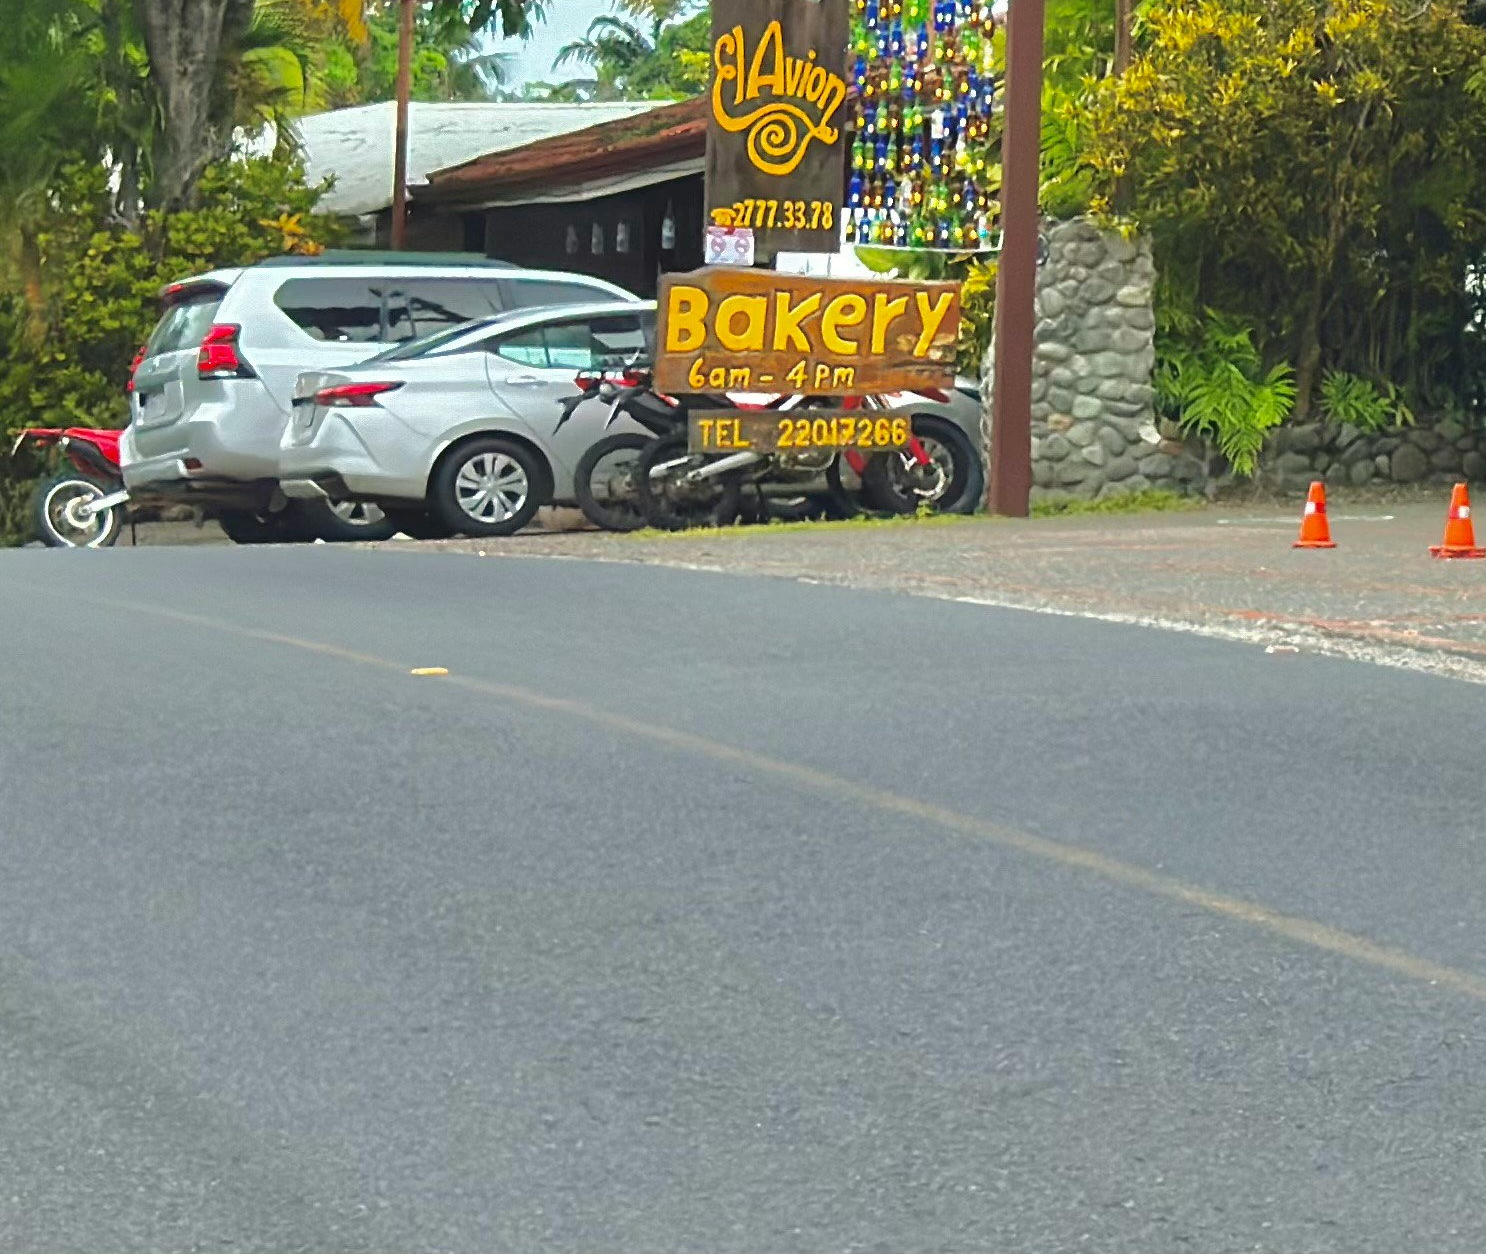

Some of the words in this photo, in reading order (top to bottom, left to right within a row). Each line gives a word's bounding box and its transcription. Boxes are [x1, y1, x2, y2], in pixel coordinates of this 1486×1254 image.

[732, 199, 833, 230] 2777.33.78
[666, 286, 954, 357] Bakery
[688, 358, 750, 389] 6am
[776, 416, 907, 447] 22017266
